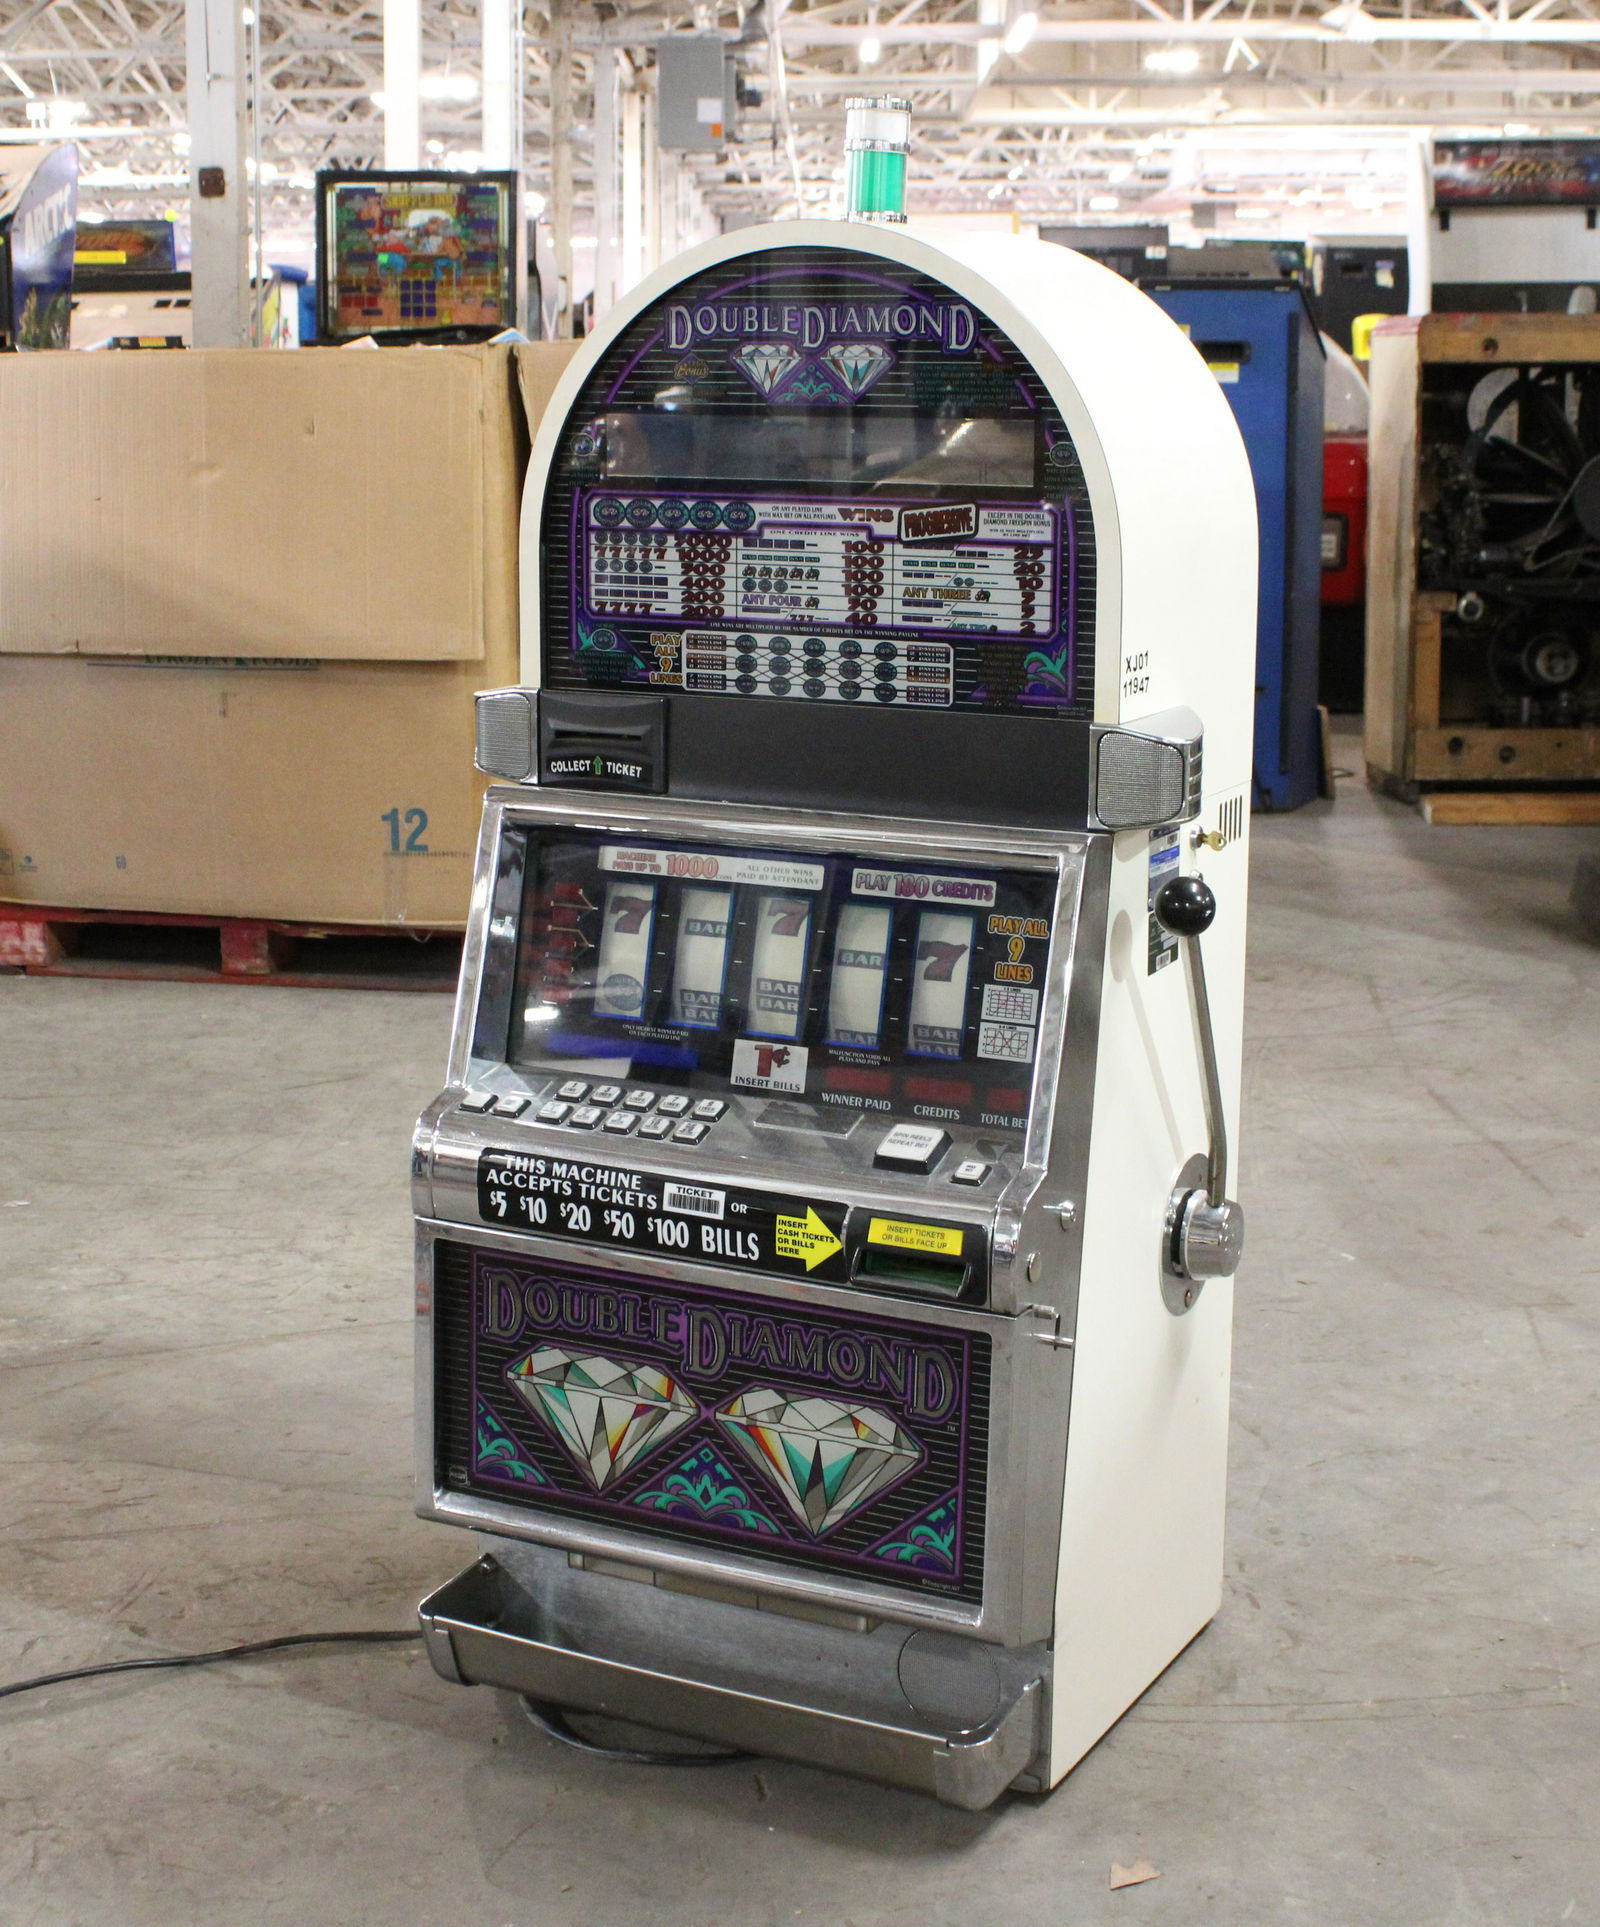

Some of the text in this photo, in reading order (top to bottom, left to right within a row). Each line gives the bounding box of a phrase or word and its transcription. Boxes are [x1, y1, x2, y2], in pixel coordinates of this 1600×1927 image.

[838, 508, 894, 522] WINS
[904, 507, 973, 538] PROGRESSIVE
[842, 540, 885, 553] 100
[676, 549, 731, 562] 1000
[842, 555, 885, 569] 100
[1013, 561, 1046, 575] 20
[842, 569, 885, 583] 100
[1015, 576, 1044, 590] 10
[679, 577, 726, 590] 400
[842, 583, 885, 597] 100
[681, 590, 725, 604] 200
[742, 594, 802, 607] ANY FOUR
[903, 587, 971, 600] ANY THREE
[681, 604, 725, 618] 200
[845, 612, 878, 625] 40
[1020, 621, 1036, 634] 2
[651, 634, 682, 646] PLAY
[654, 647, 678, 657] ALL
[659, 658, 672, 672] 9
[1126, 650, 1149, 673] XJ01
[651, 672, 682, 685] LINES
[1123, 677, 1150, 698] 11947
[551, 760, 642, 778] COLLECT TICKET
[381, 807, 429, 853] 12
[617, 851, 656, 863] MACHINE
[635, 862, 647, 872] UP
[649, 863, 661, 873] TO
[666, 854, 719, 879] 1000
[747, 864, 814, 876] ALL OTHER WINS
[736, 872, 756, 880] PAID
[772, 874, 819, 885] ATTENDANT
[856, 873, 891, 891] PLAY
[932, 880, 993, 901] CREDITS
[610, 896, 652, 935] 7
[767, 901, 809, 937] 7
[689, 922, 727, 936] BAR
[989, 916, 1049, 937] PLAY ALL
[1009, 936, 1024, 963] 9
[841, 952, 882, 964] BAR
[917, 940, 968, 982] 7
[994, 963, 1033, 983] LINES
[759, 980, 799, 995] BAR
[683, 992, 721, 1005] BAR
[759, 998, 799, 1012] BAR
[684, 1008, 719, 1020] BAR
[839, 1033, 877, 1046] BAR
[916, 1027, 960, 1041] BAR
[829, 1049, 864, 1058] MALFUNCTION
[916, 1045, 959, 1057] BAR
[755, 1045, 791, 1077] 1¢
[735, 1075, 801, 1092] INSERT BILLS
[821, 1093, 891, 1111] WINNER PAID
[914, 1105, 960, 1120] CREDITS
[981, 1113, 1029, 1128] TOTAL BET
[505, 1154, 642, 1191] THIS MACHINE
[486, 1170, 657, 1210] ACCEPTS TICKETS
[676, 1186, 714, 1199] TICKET
[731, 1202, 747, 1215] OR
[490, 1190, 759, 1261] $5 $10 $20 $50 $100 BILLS
[778, 1219, 808, 1230] INSERT
[778, 1228, 835, 1244] CASH TICKETS
[887, 1225, 945, 1240] INSERT TICKETS
[778, 1237, 815, 1249] OR BILLS
[882, 1233, 893, 1241] OR
[895, 1235, 914, 1245] BILLS
[916, 1239, 935, 1248] FACE
[778, 1245, 800, 1256] HERE
